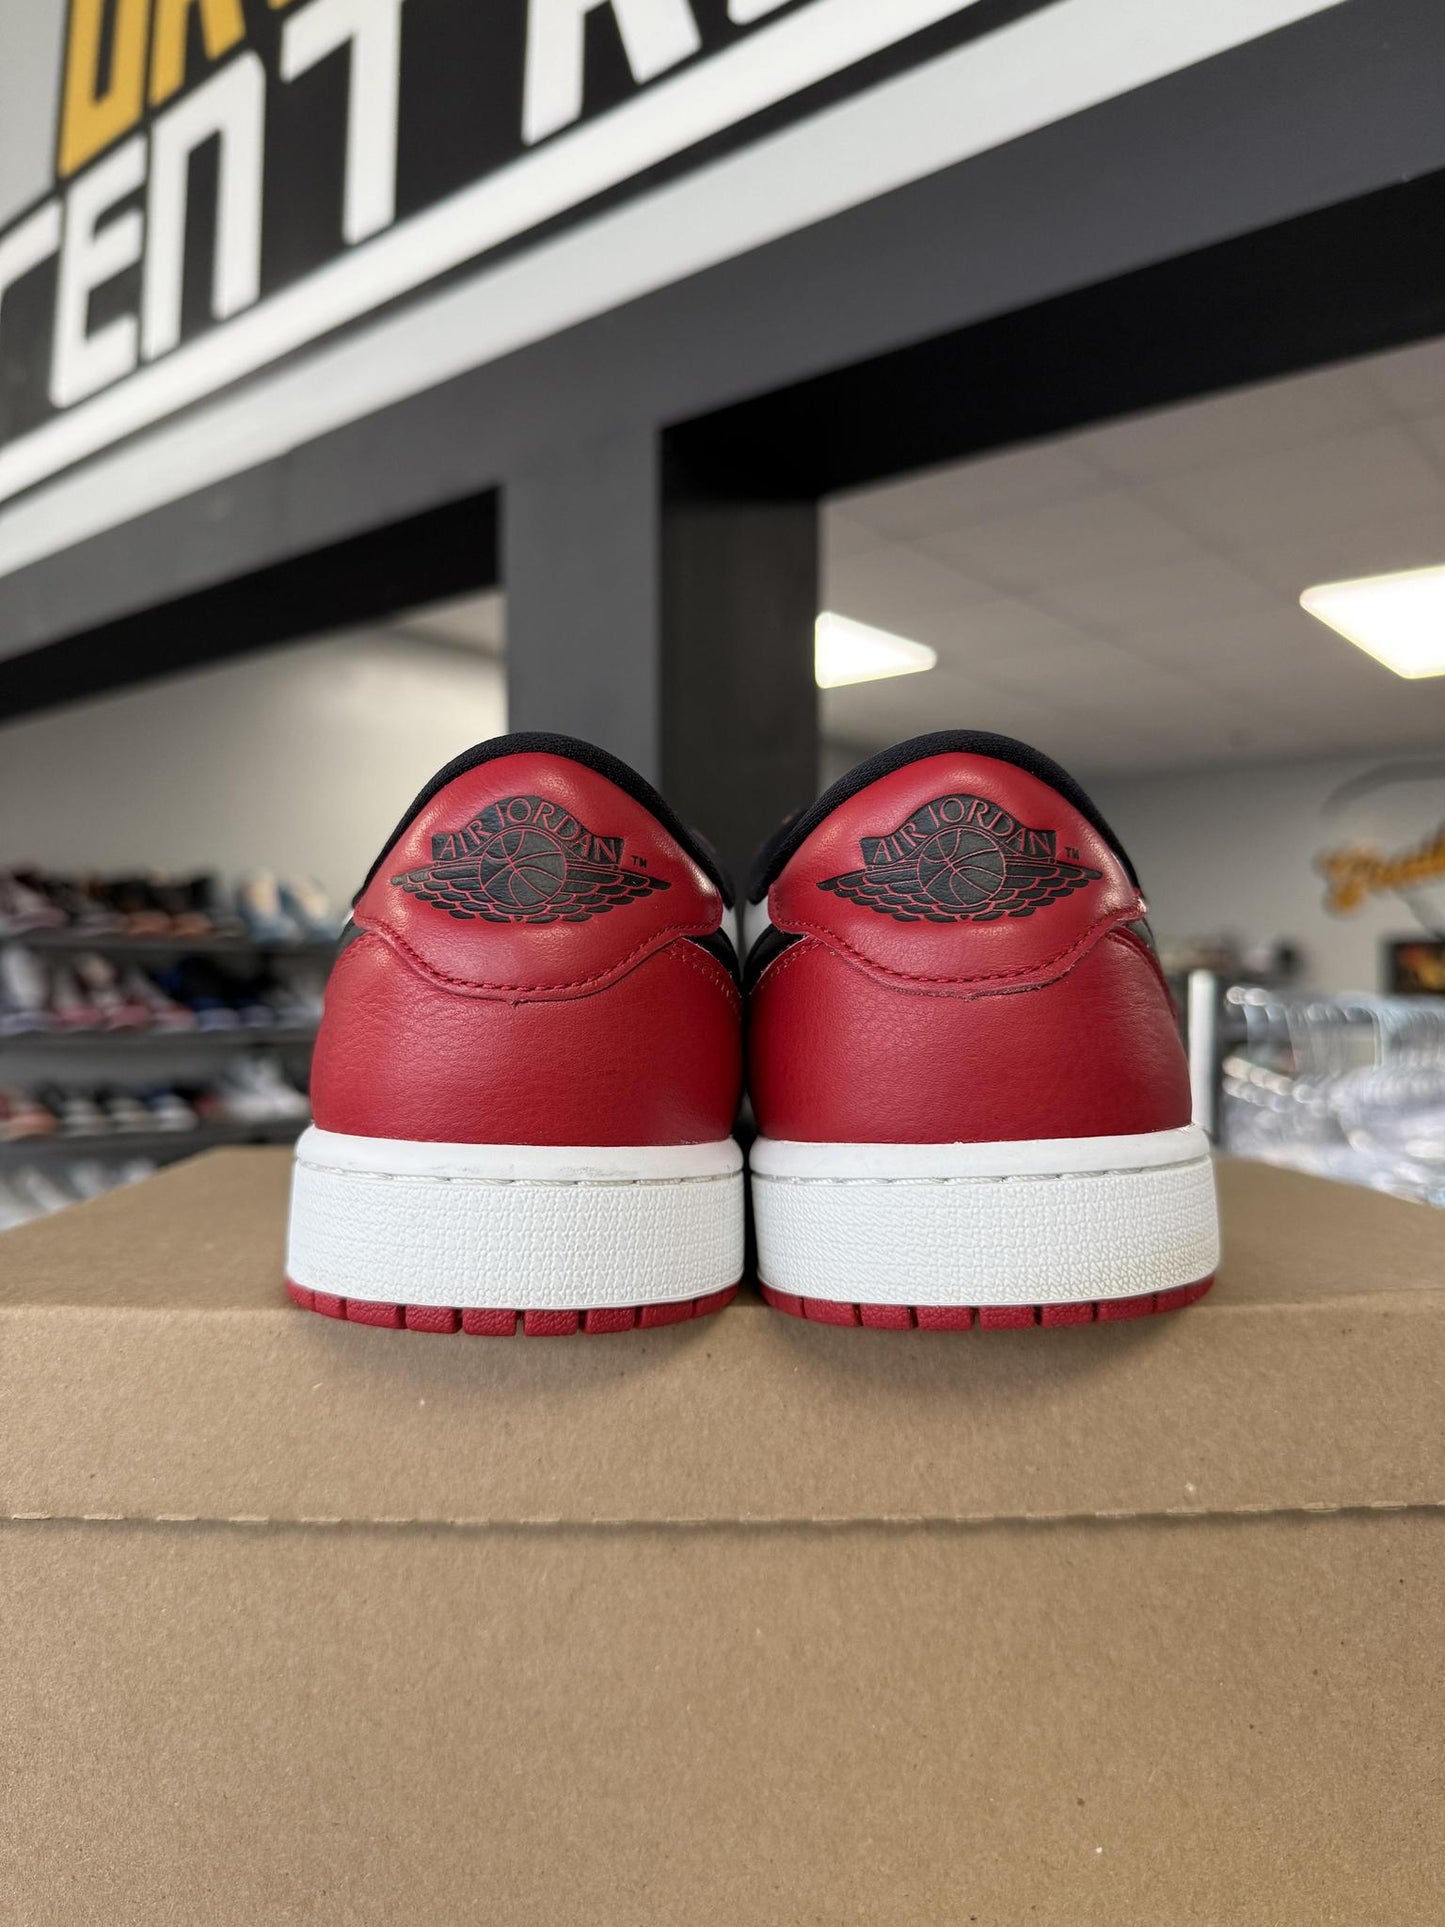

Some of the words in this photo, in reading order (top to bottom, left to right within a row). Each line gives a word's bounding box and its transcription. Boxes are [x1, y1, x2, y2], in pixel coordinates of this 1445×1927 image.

[440, 820, 494, 858] AIR
[495, 798, 617, 862] JORDAN
[873, 822, 928, 863] AIR
[927, 798, 1052, 857] JORDAN
